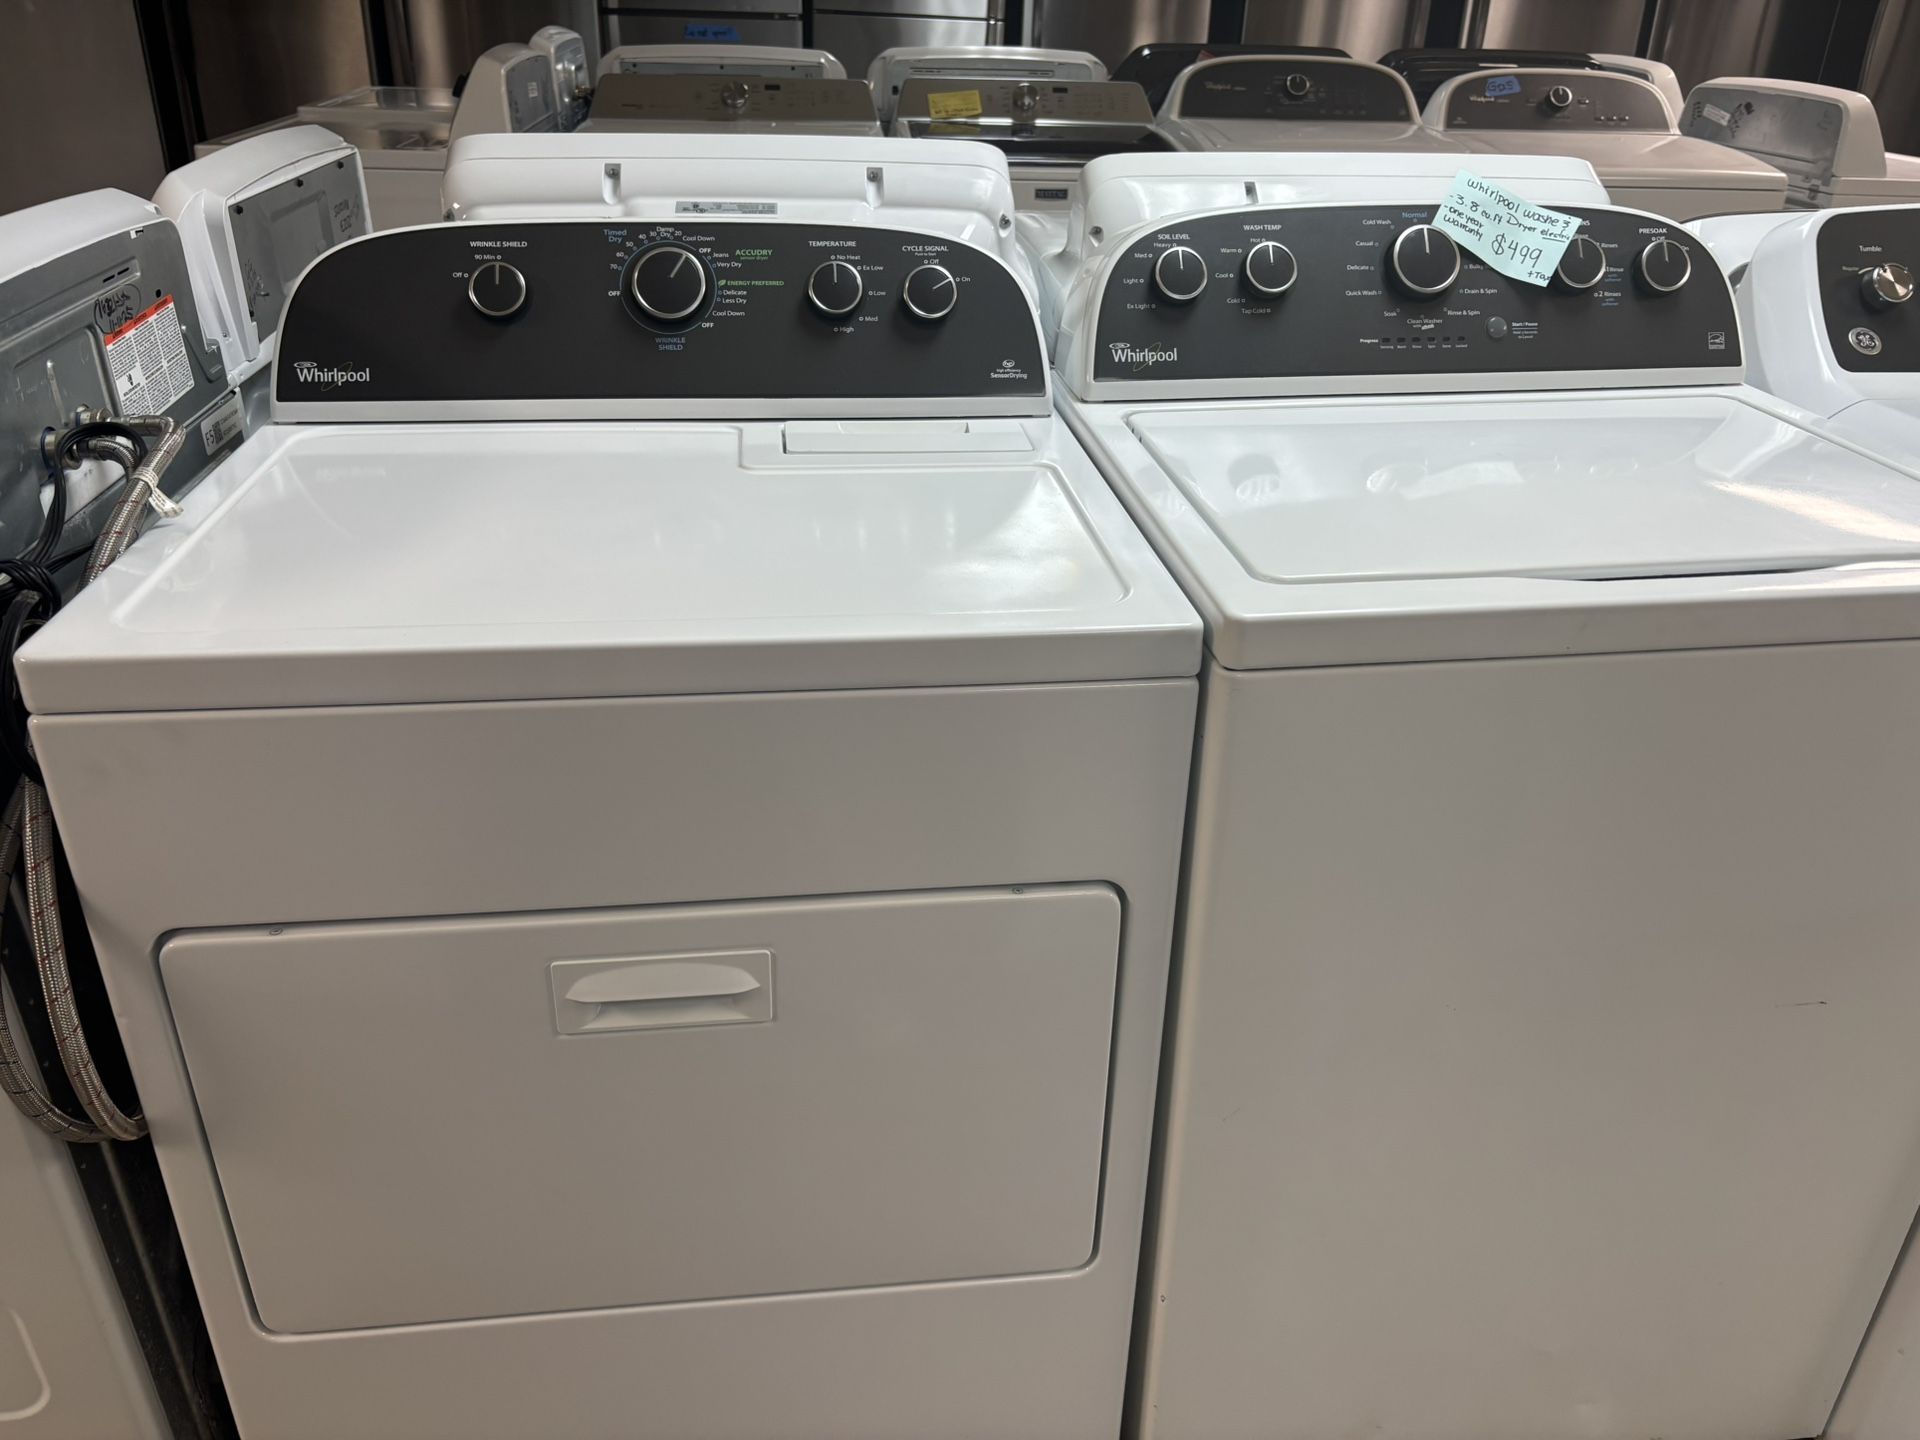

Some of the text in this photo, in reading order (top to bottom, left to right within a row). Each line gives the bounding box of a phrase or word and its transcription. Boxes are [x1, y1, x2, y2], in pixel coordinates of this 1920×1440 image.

[1506, 212, 1538, 233] Dryer
[656, 226, 674, 234] Damp
[608, 236, 622, 244] Dry
[808, 240, 857, 248] TEMPERATURE
[1492, 233, 1544, 269] $499
[840, 326, 854, 334] High
[1112, 348, 1178, 365] Whirlpool
[296, 368, 370, 386] Whirlpool
